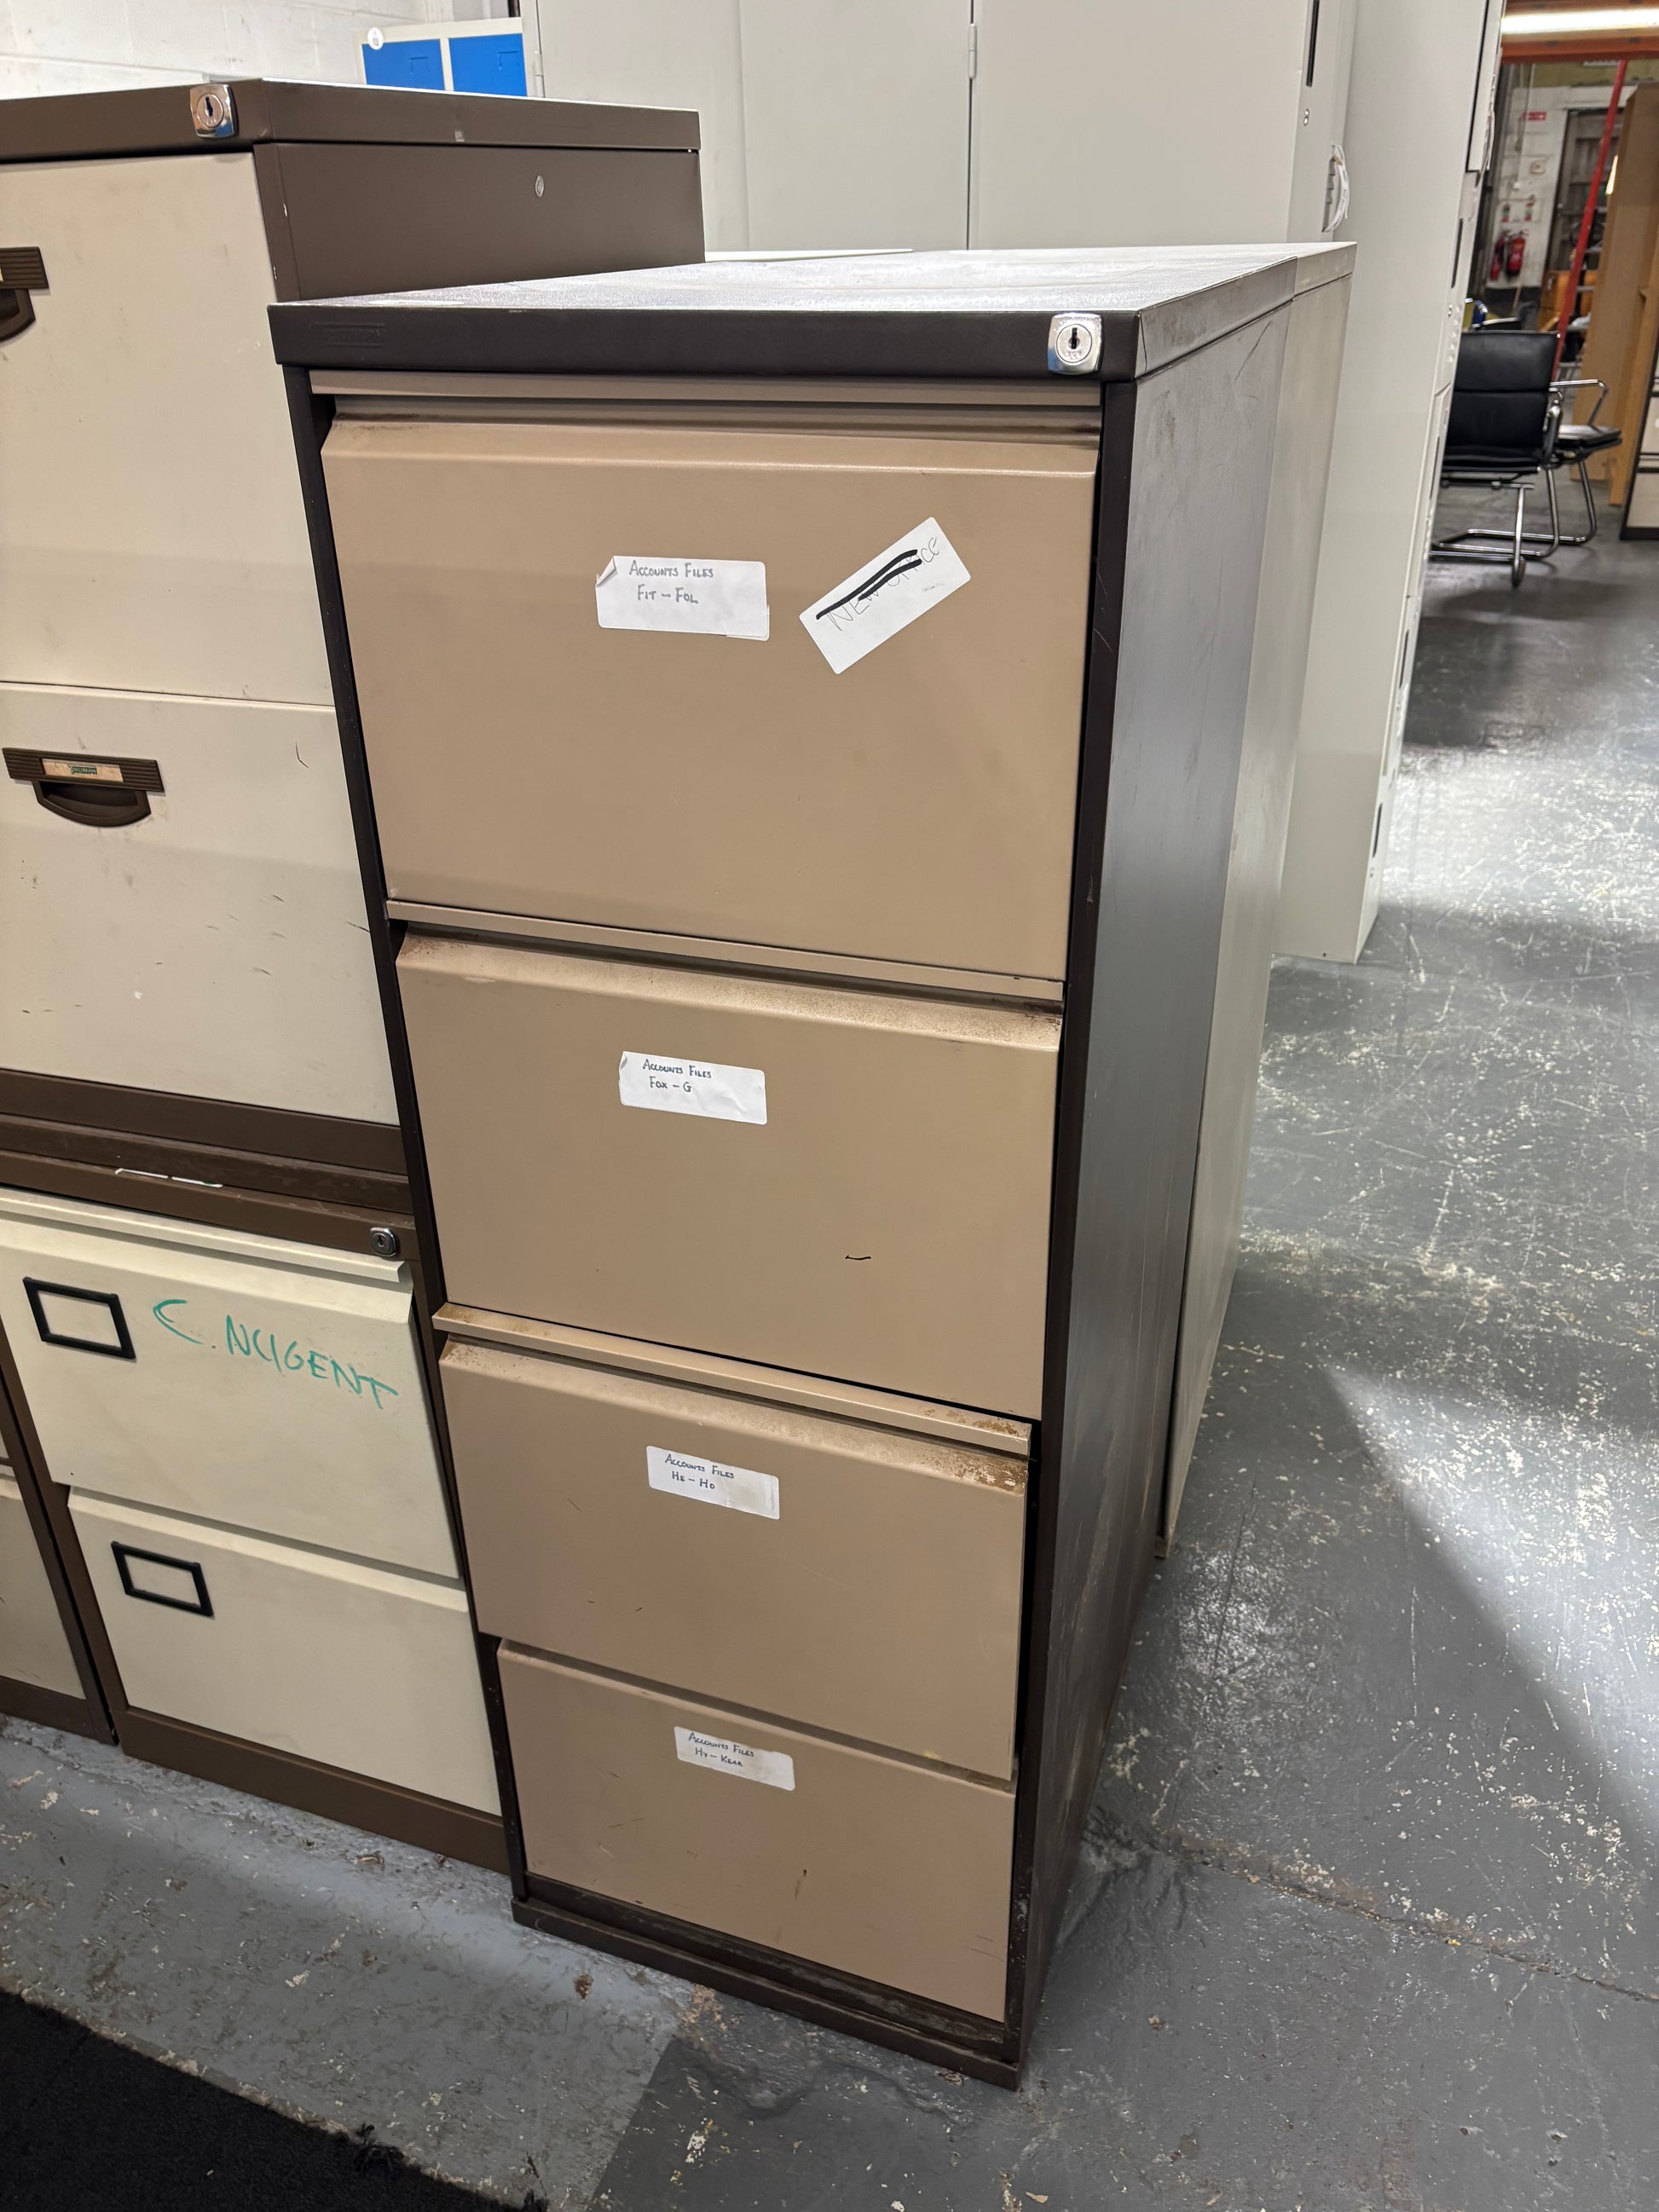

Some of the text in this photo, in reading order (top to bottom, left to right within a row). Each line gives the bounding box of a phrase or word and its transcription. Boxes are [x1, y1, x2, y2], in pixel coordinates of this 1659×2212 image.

[628, 559, 714, 578] ACCOUNTS FILES
[637, 583, 656, 601] FIT
[675, 586, 699, 604] FOL
[642, 1059, 712, 1078] ACCOUNTS FILES
[683, 1082, 692, 1093] G
[664, 1453, 735, 1479] ACCOUNTS FILES
